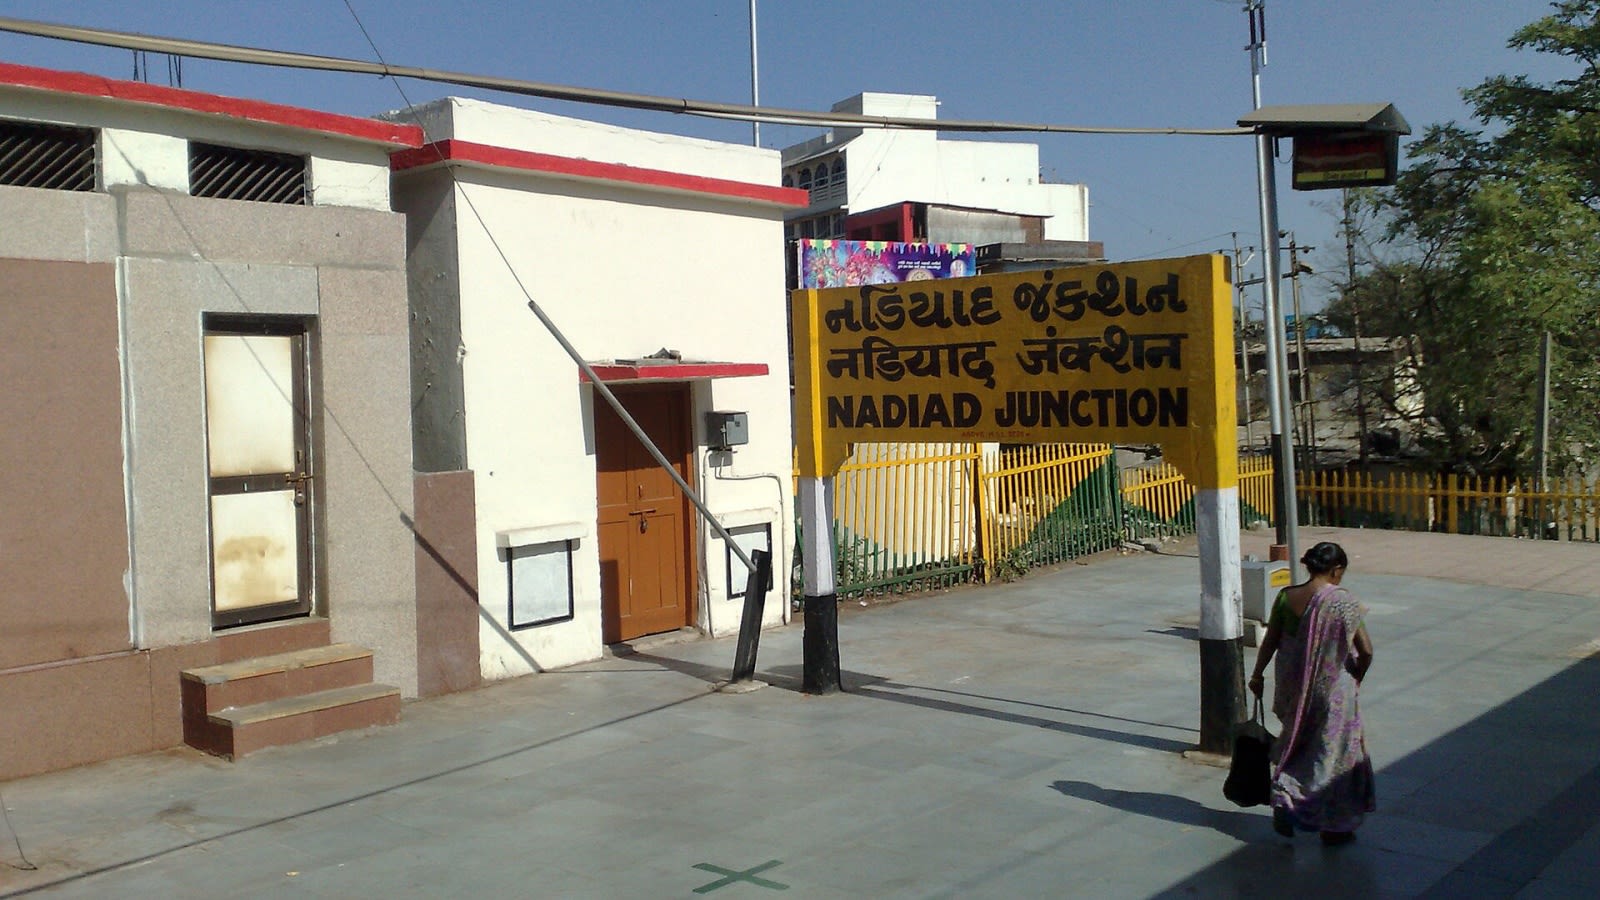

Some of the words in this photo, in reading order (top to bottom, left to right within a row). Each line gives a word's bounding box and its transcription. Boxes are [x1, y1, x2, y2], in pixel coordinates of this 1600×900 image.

[825, 285, 1002, 333] નડિયાદ
[826, 336, 997, 389] नडियाद
[828, 393, 983, 429] NADIAD
[994, 387, 1188, 429] JUNCTION
